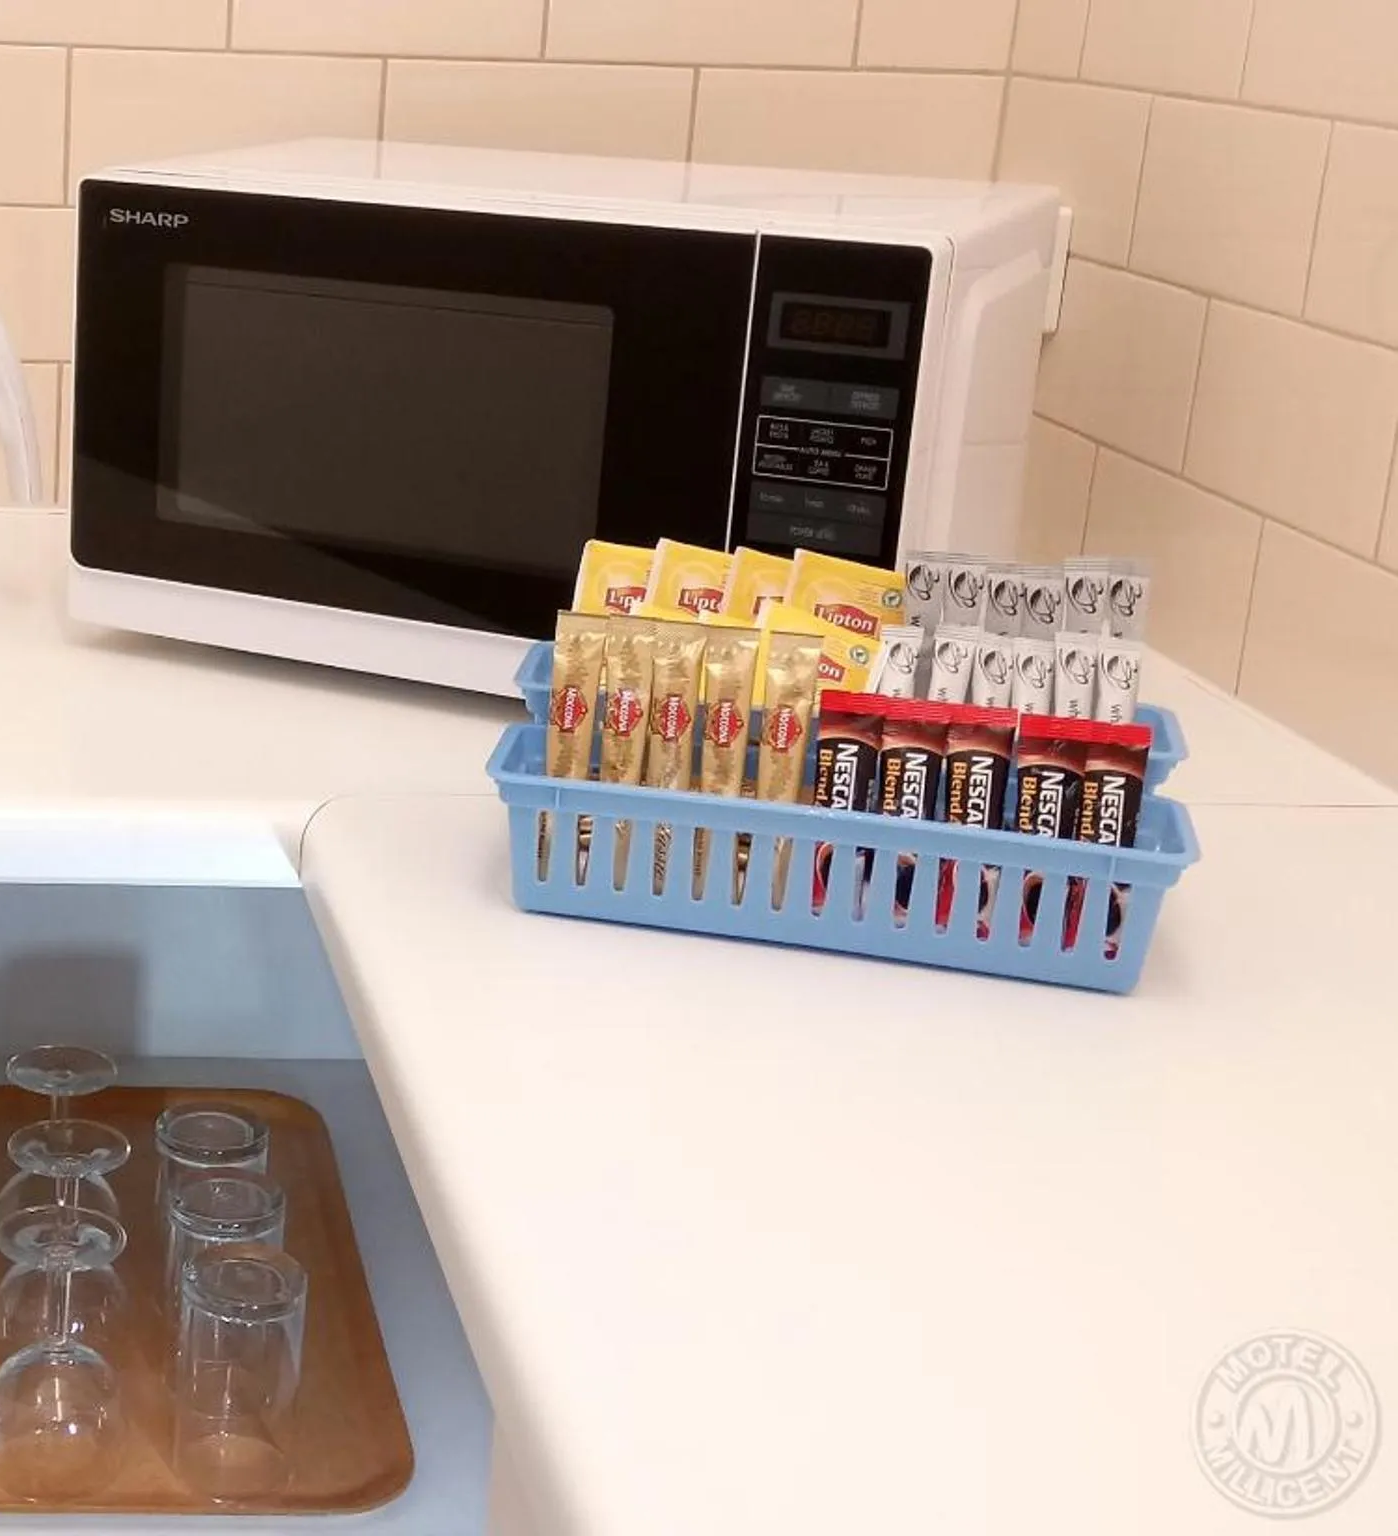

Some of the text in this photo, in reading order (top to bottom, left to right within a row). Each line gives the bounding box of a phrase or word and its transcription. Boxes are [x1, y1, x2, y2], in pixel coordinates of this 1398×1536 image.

[109, 208, 190, 228] SHARP
[817, 606, 875, 633] Lipton
[816, 749, 833, 801] Blend
[883, 758, 901, 811] Blend
[950, 762, 967, 814] Blend
[1019, 776, 1037, 832] Blend
[1081, 782, 1099, 835] Blend
